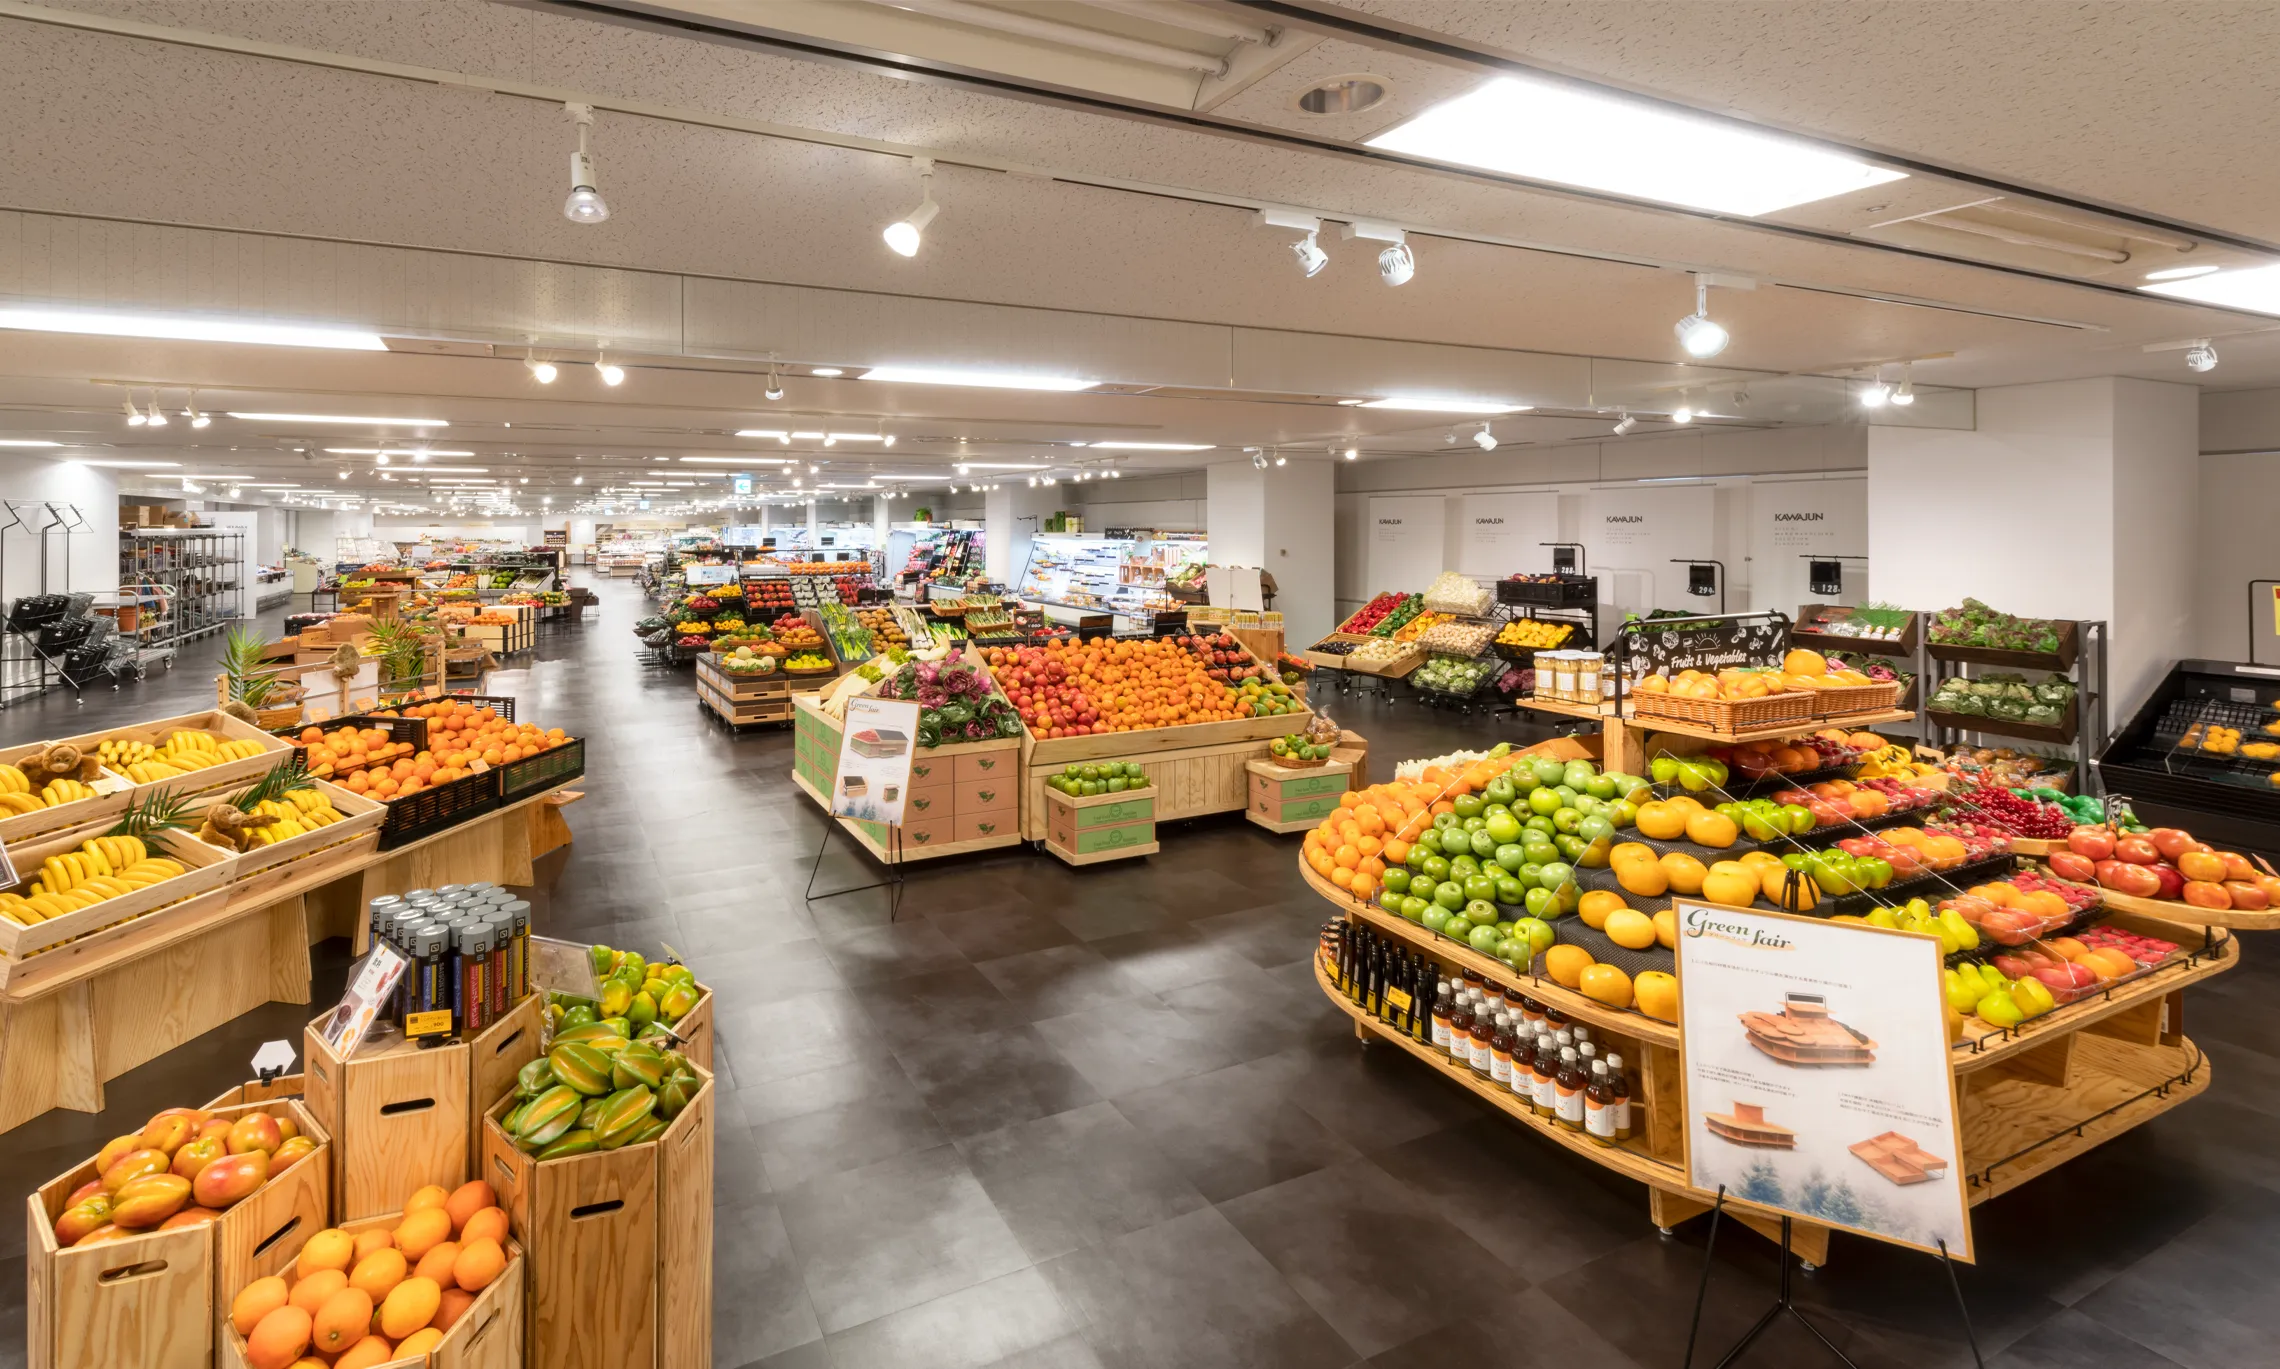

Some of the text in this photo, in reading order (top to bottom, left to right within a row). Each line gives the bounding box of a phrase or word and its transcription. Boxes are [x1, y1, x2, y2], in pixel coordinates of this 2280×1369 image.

[1606, 515, 1643, 523] KAWAJUN
[1774, 512, 1824, 521] KAWAJUN
[1822, 583, 1839, 593] 128
[1670, 649, 1748, 671] Fruits & Vegetables
[850, 698, 869, 712] Green
[1686, 908, 1791, 949] Green fair
